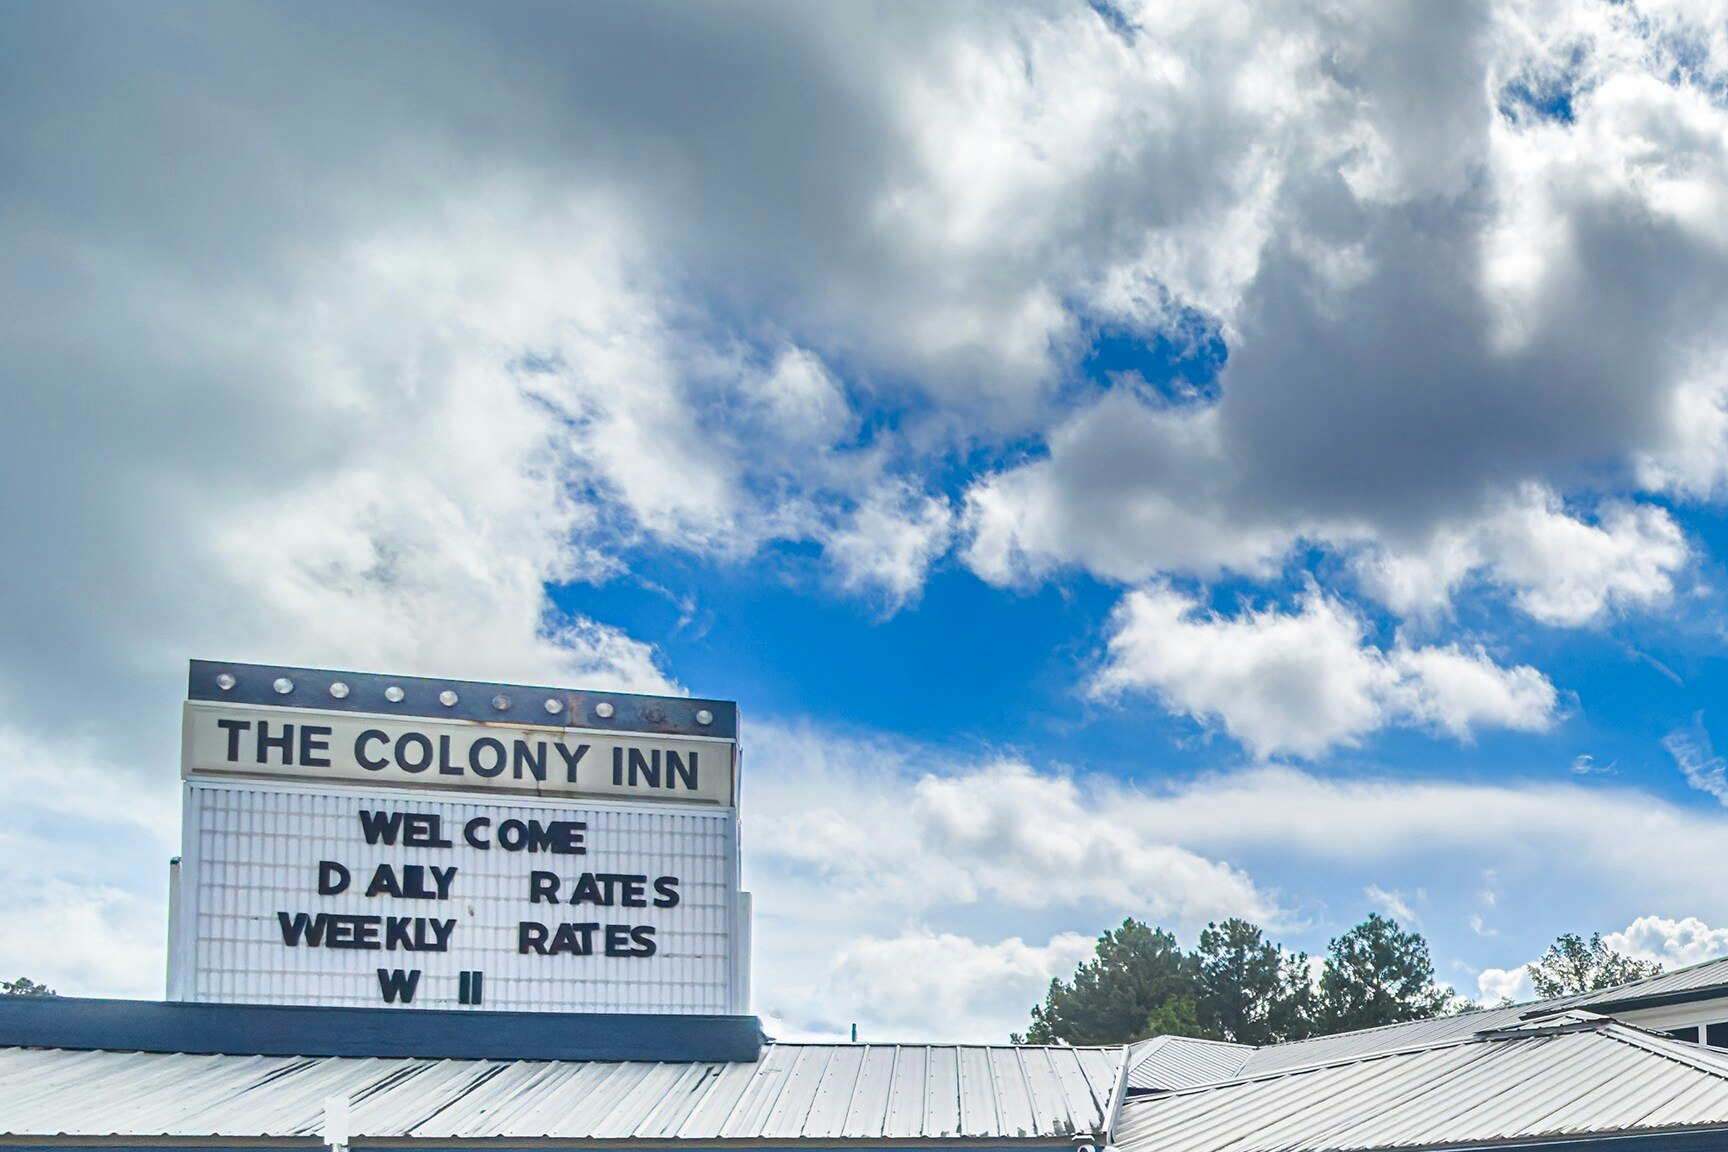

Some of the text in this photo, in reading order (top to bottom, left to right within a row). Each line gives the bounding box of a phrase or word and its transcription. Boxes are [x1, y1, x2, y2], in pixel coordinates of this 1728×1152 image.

[217, 719, 698, 790] THE COLONY INN
[359, 810, 587, 855] WELCOME
[318, 861, 680, 908] DAILY RATES
[278, 912, 656, 957] WEEKLY RATES
[377, 968, 420, 1004] W
